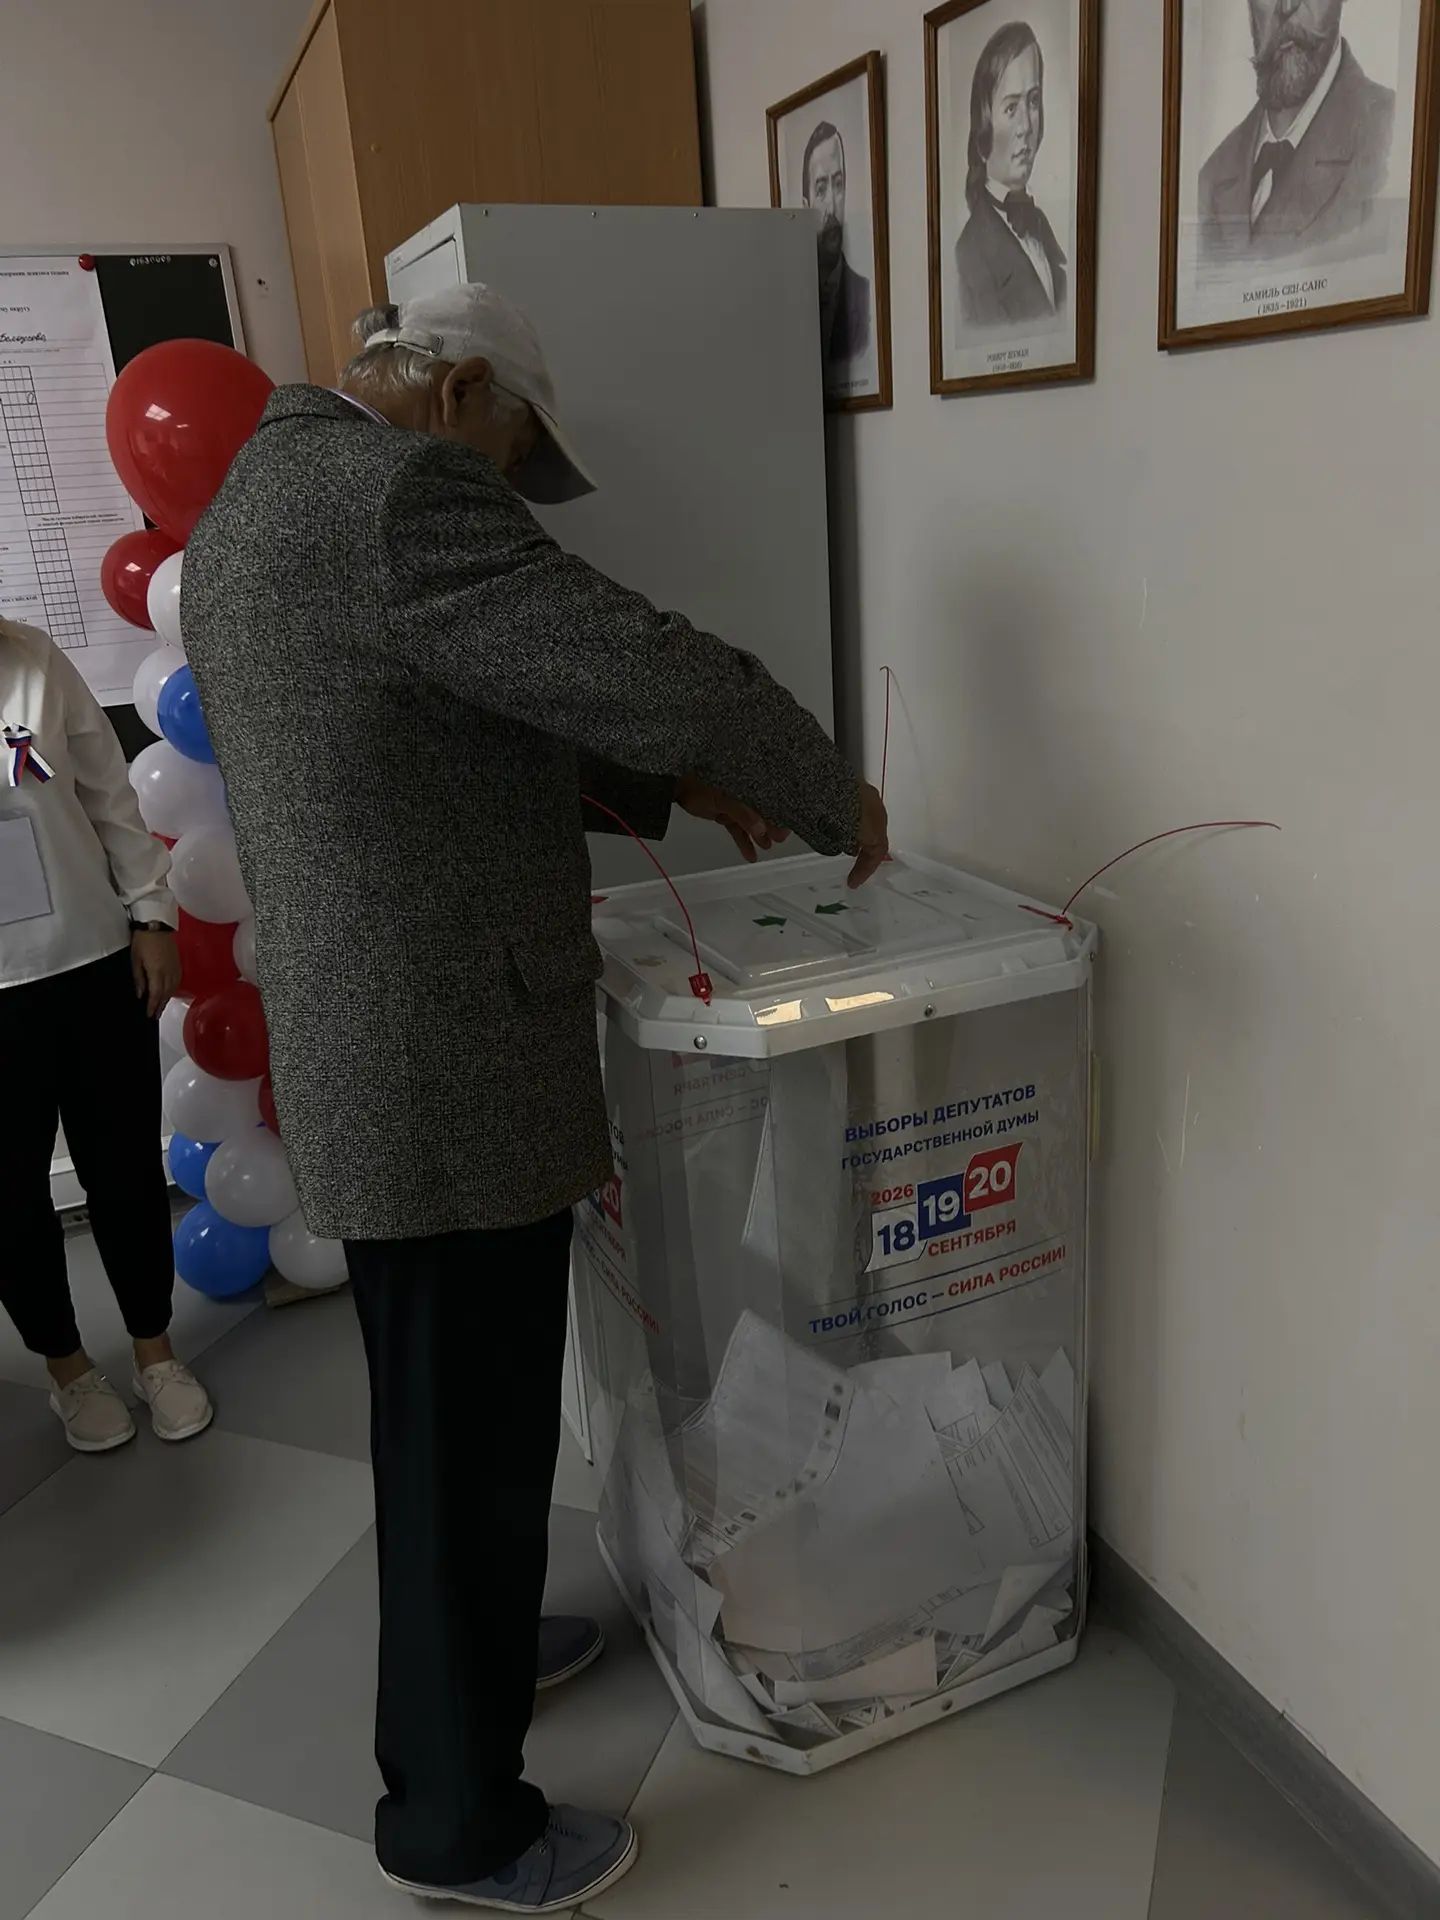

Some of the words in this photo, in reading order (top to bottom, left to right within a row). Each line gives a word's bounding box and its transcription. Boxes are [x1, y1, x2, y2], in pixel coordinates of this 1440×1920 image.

[1243, 288, 1279, 303] КАМИЛЬ
[1282, 279, 1328, 296] СЕН-САНС
[845, 1111, 927, 1142] ВЫБОРЫ
[933, 1084, 1036, 1123] ДЕПУТАТОВ
[842, 1121, 993, 1170] ГОСУДАРСТВЕННОЙ
[997, 1110, 1039, 1134] ДУМЫ
[870, 1184, 914, 1205] 2026
[968, 1161, 1011, 1200] 20
[923, 1190, 960, 1227] 19
[877, 1220, 916, 1255] 18
[928, 1219, 1016, 1257] СЕНТЯБРЯ
[809, 1305, 862, 1334] ТВОЙ
[867, 1292, 927, 1320] ГОЛОС
[948, 1274, 995, 1297] СИЛА
[1000, 1245, 1066, 1281] РОССИИ!
